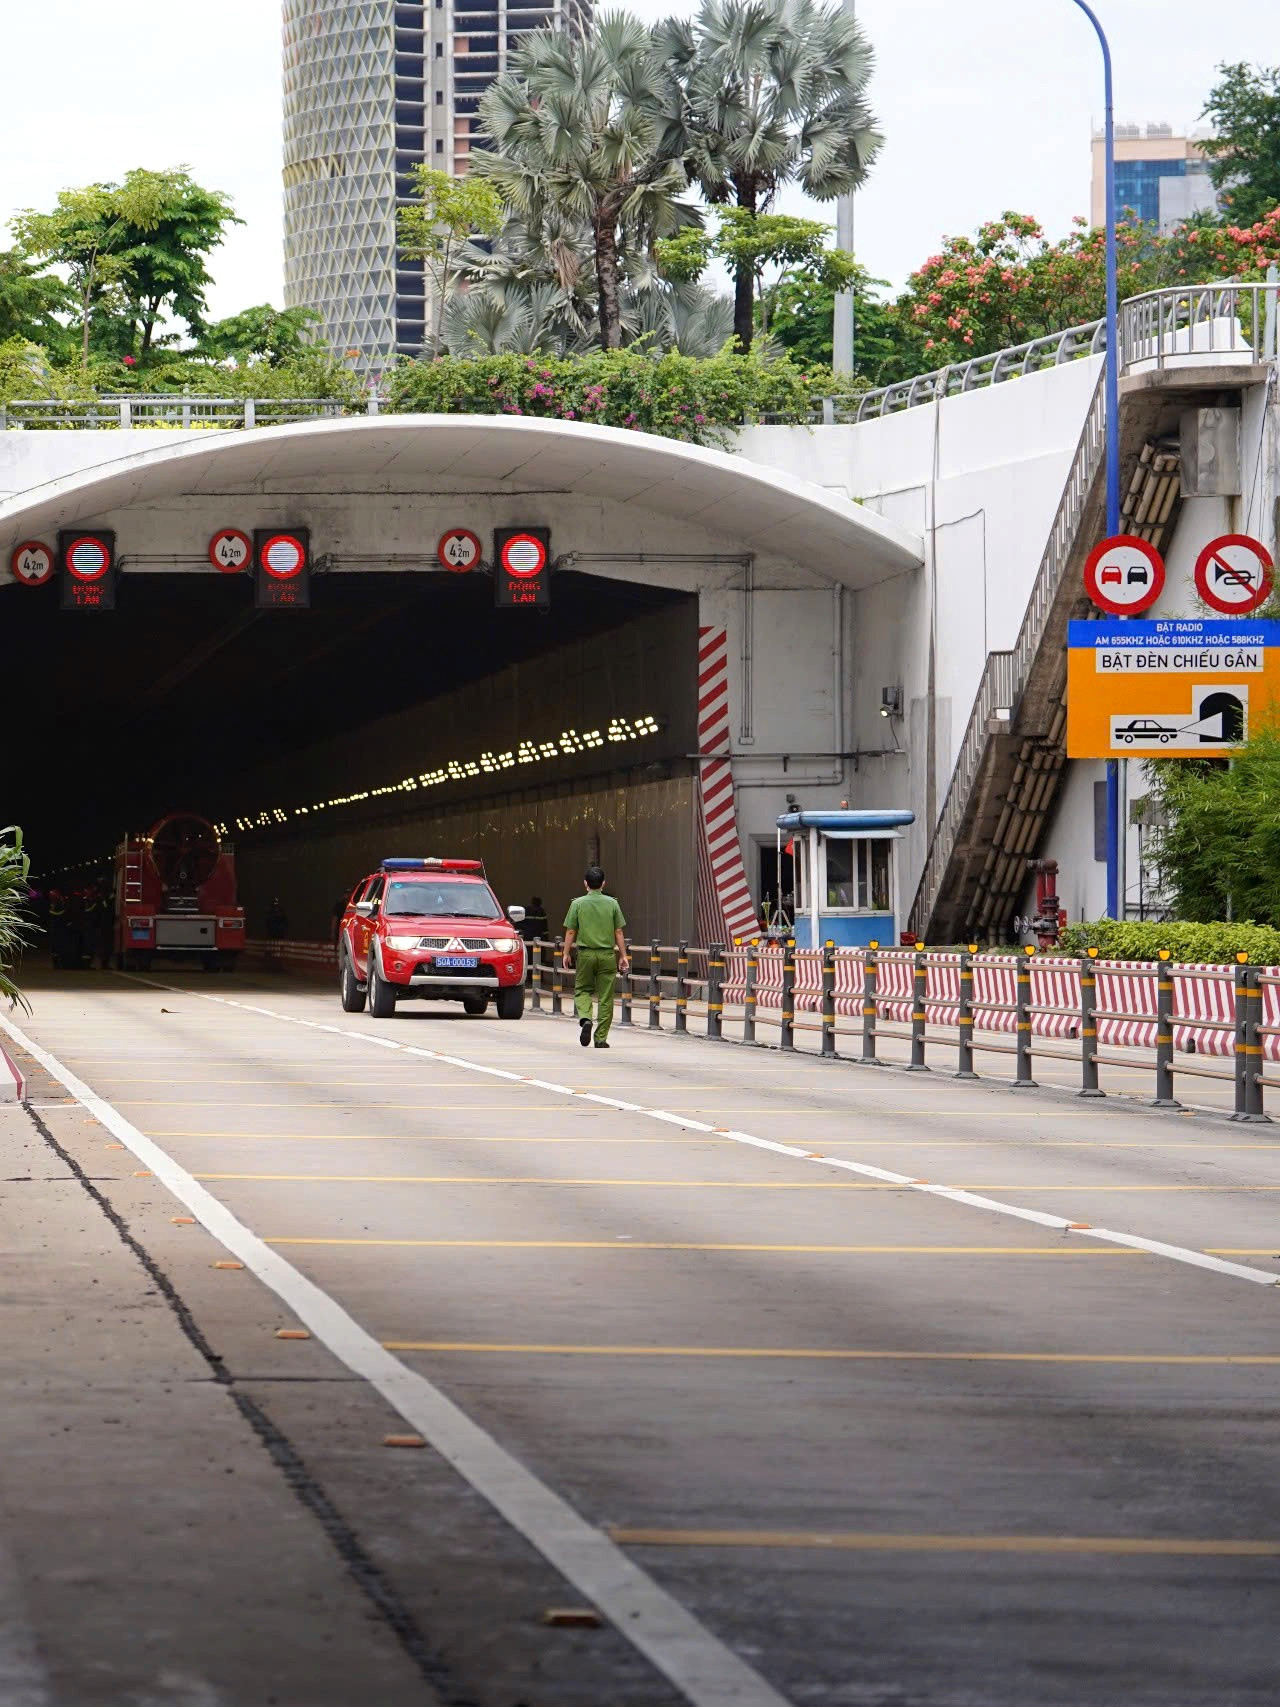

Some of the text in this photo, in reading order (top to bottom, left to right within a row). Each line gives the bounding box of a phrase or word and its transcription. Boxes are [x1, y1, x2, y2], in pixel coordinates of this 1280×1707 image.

[1156, 622, 1203, 634] BẬT RADIO
[1095, 634, 1264, 647] AM 655KHZ HOẶC 610KHZ HOẶC 588KHZ
[1102, 648, 1257, 671] BẬT ĐÈN CHIẾU GẦN
